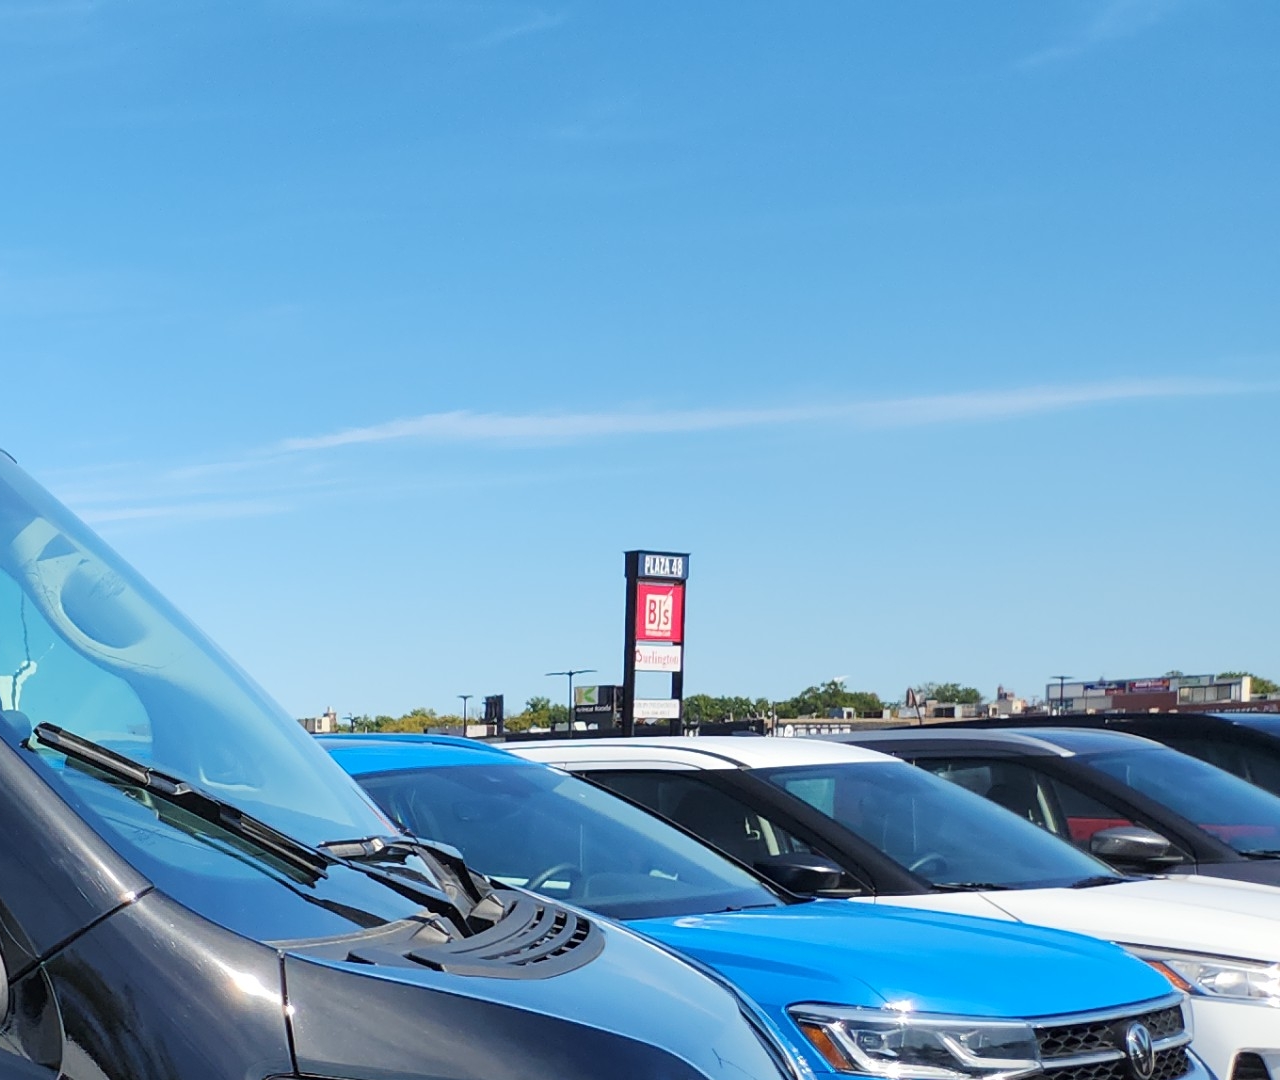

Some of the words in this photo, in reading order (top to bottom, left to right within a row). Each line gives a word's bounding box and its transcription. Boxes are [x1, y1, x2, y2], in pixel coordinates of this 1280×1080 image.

[645, 556, 670, 575] PLAZA
[672, 557, 682, 577] 48
[648, 599, 670, 630] BJ's
[635, 650, 679, 667] Burlington
